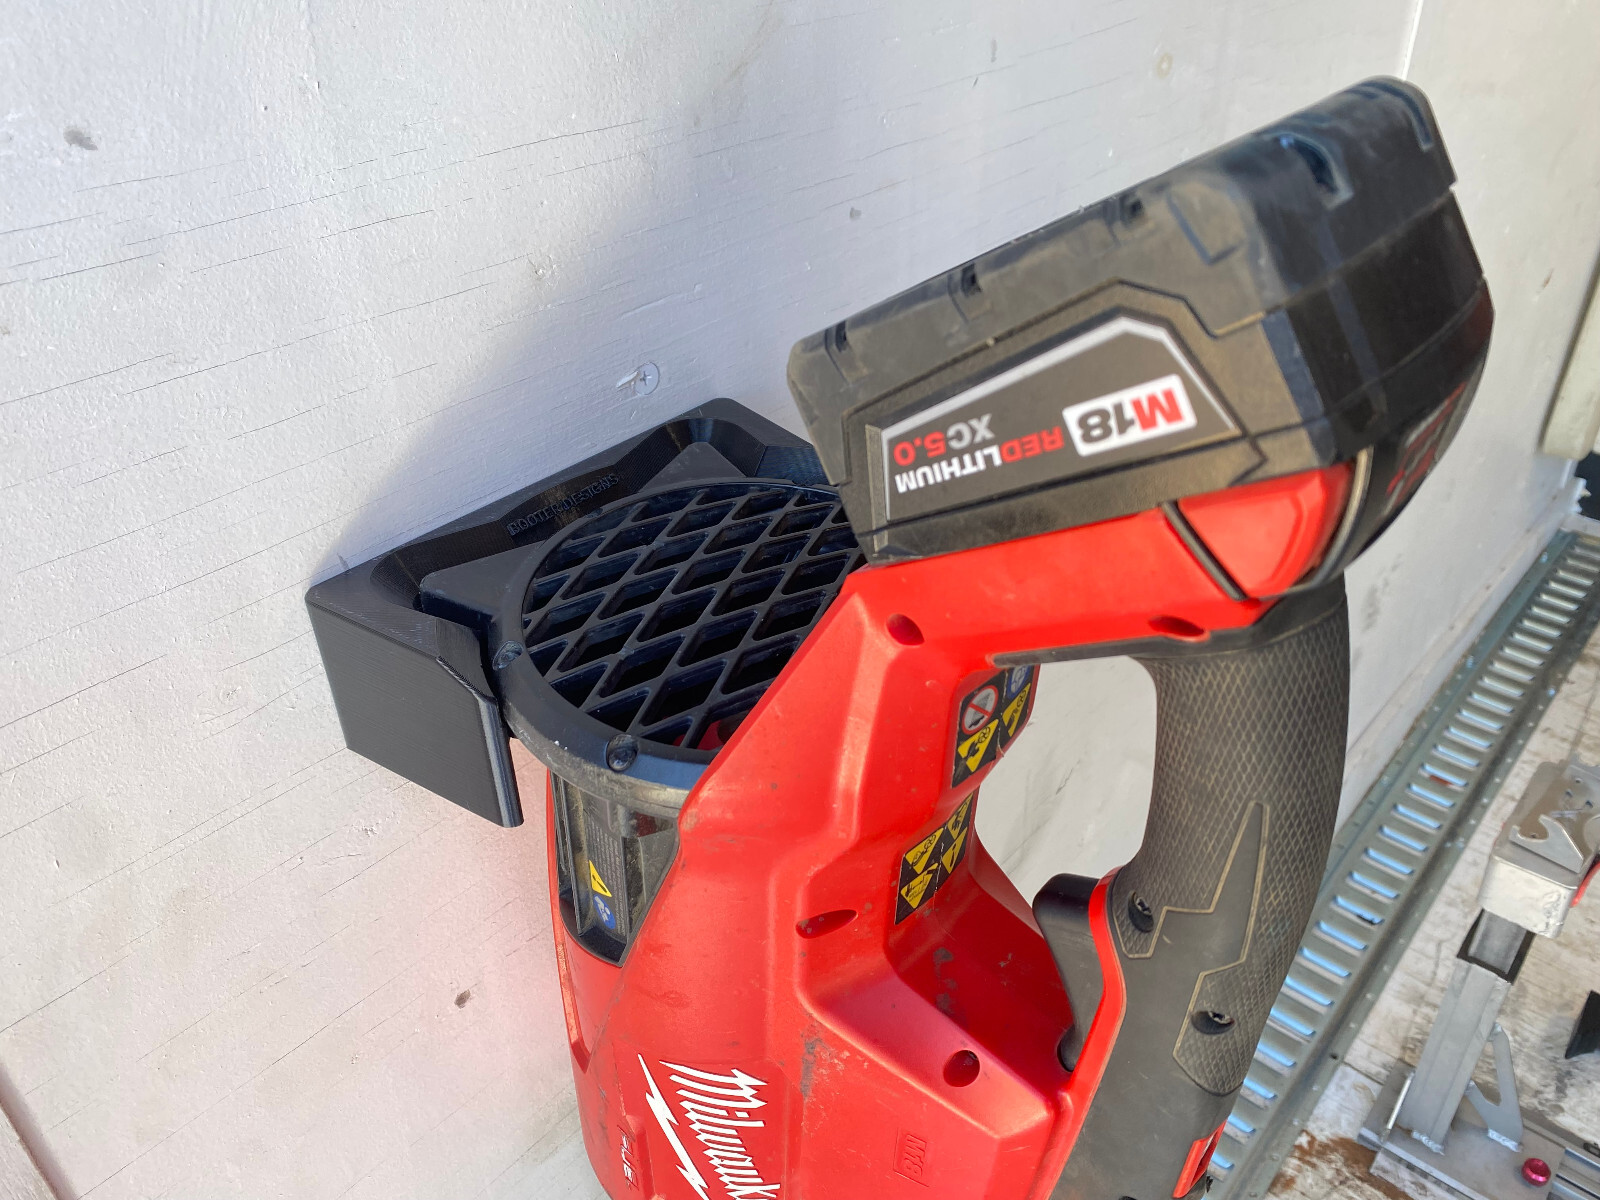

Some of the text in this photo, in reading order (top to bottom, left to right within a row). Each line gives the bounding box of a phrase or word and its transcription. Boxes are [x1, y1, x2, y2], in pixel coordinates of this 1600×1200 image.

[1077, 389, 1184, 444] M18
[895, 426, 1065, 494] REDLITHIUM
[561, 473, 619, 511] DESIGNS
